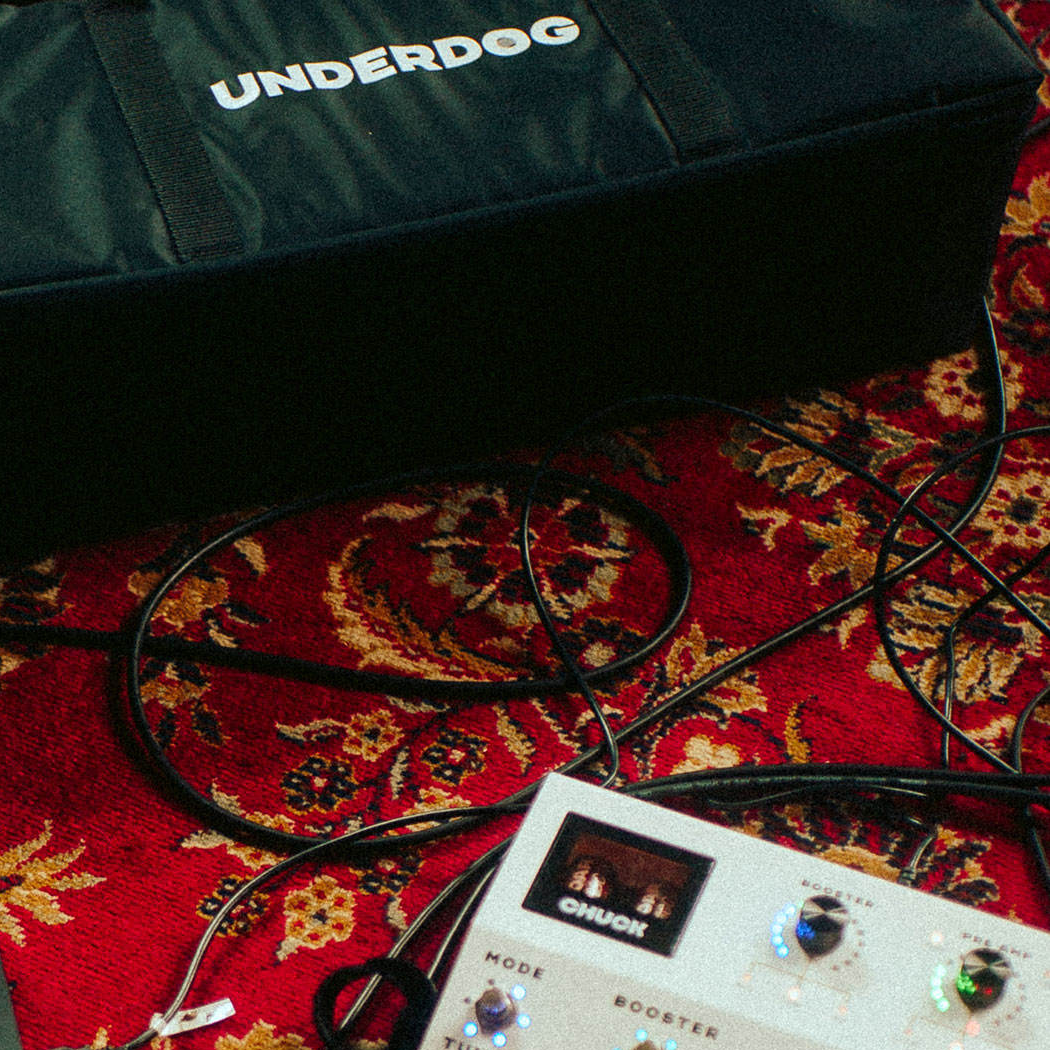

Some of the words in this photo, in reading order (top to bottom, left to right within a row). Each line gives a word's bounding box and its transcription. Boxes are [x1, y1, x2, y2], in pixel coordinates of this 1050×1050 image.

[209, 15, 581, 110] UNDERDOG
[801, 879, 874, 908] BOOSTER
[558, 896, 650, 940] CHUCK
[484, 950, 546, 980] MODE
[613, 994, 720, 1041] BOOSTER
